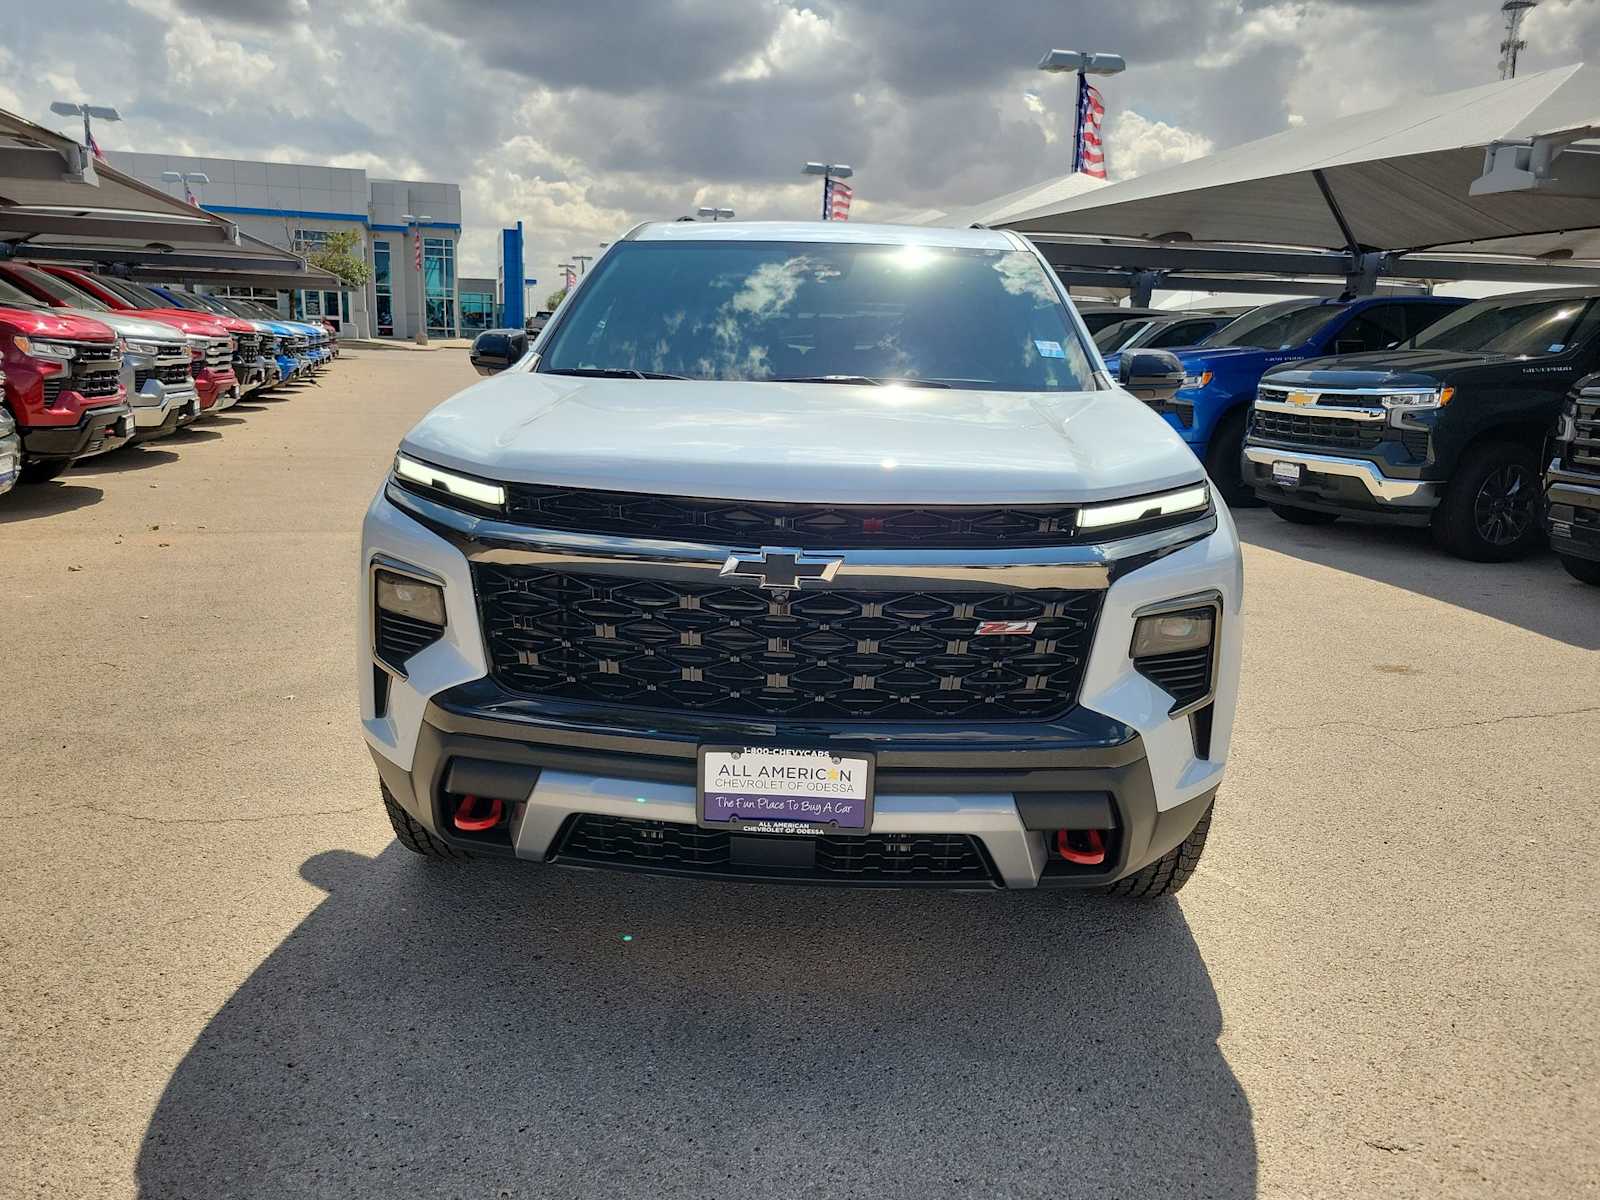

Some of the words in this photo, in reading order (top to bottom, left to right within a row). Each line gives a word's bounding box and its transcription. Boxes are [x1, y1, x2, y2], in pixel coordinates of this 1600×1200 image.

[718, 764, 751, 777] ALL
[715, 779, 784, 790] CHEVROLET
[788, 782, 801, 790] OF
[807, 783, 854, 792] ODESSA
[716, 797, 734, 808] The
[736, 798, 755, 809] Fun
[758, 798, 784, 810] Place
[788, 800, 800, 810] To
[801, 801, 822, 814] Buy
[823, 803, 833, 812] A
[835, 803, 852, 813] Car
